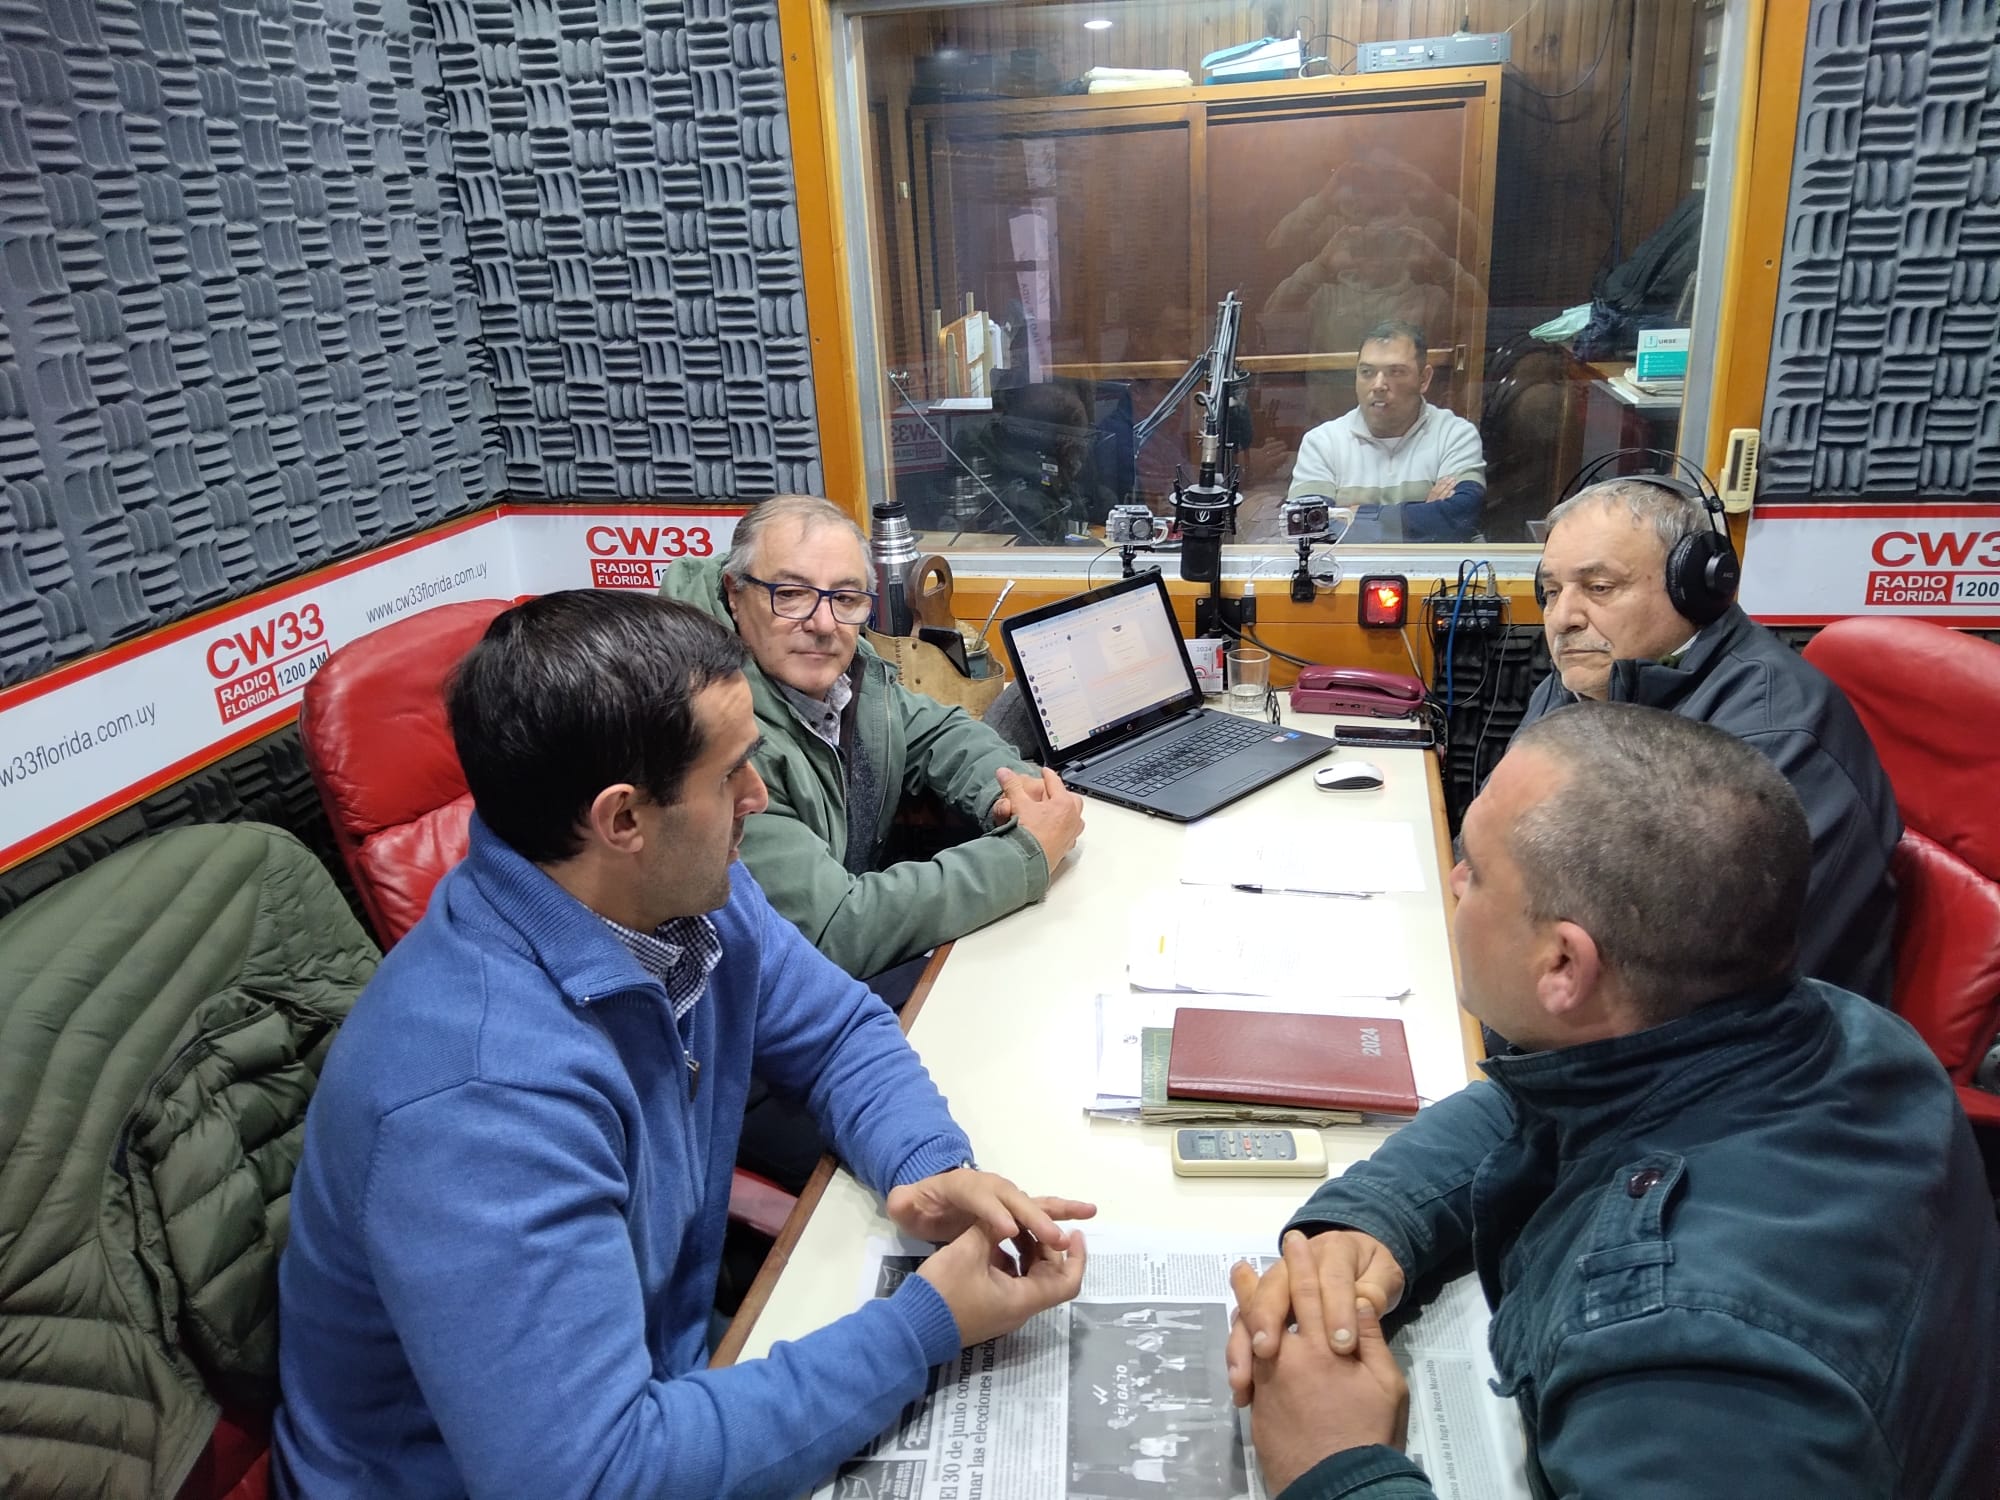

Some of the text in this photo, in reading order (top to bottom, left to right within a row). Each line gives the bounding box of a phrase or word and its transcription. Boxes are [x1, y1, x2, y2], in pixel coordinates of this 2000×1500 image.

[586, 526, 713, 557] CW33
[595, 562, 647, 574] RADIO
[598, 576, 651, 585] FLORIDA
[1874, 575, 1947, 588] RADIO
[1956, 581, 1999, 597] 1200
[366, 561, 487, 623] www.cw33florida.com.uy
[1872, 590, 1947, 602] FLORIDA
[206, 603, 324, 679] CW33
[277, 651, 327, 687] 1200 AM
[220, 671, 271, 704] RADIO
[224, 687, 277, 719] FLORIDA
[1360, 1028, 1382, 1056] 2024
[1425, 1359, 1438, 1390] Morabito
[970, 1375, 992, 1444] elecciones
[1432, 1391, 1443, 1412] Rocco
[948, 1402, 969, 1438] junio
[1435, 1413, 1445, 1423] de
[1439, 1424, 1449, 1441] fuga
[945, 1440, 963, 1459] de
[967, 1447, 986, 1468] las
[1443, 1451, 1453, 1461] de
[942, 1463, 961, 1482] 30
[1446, 1462, 1457, 1480] años
[939, 1486, 958, 1500] El
